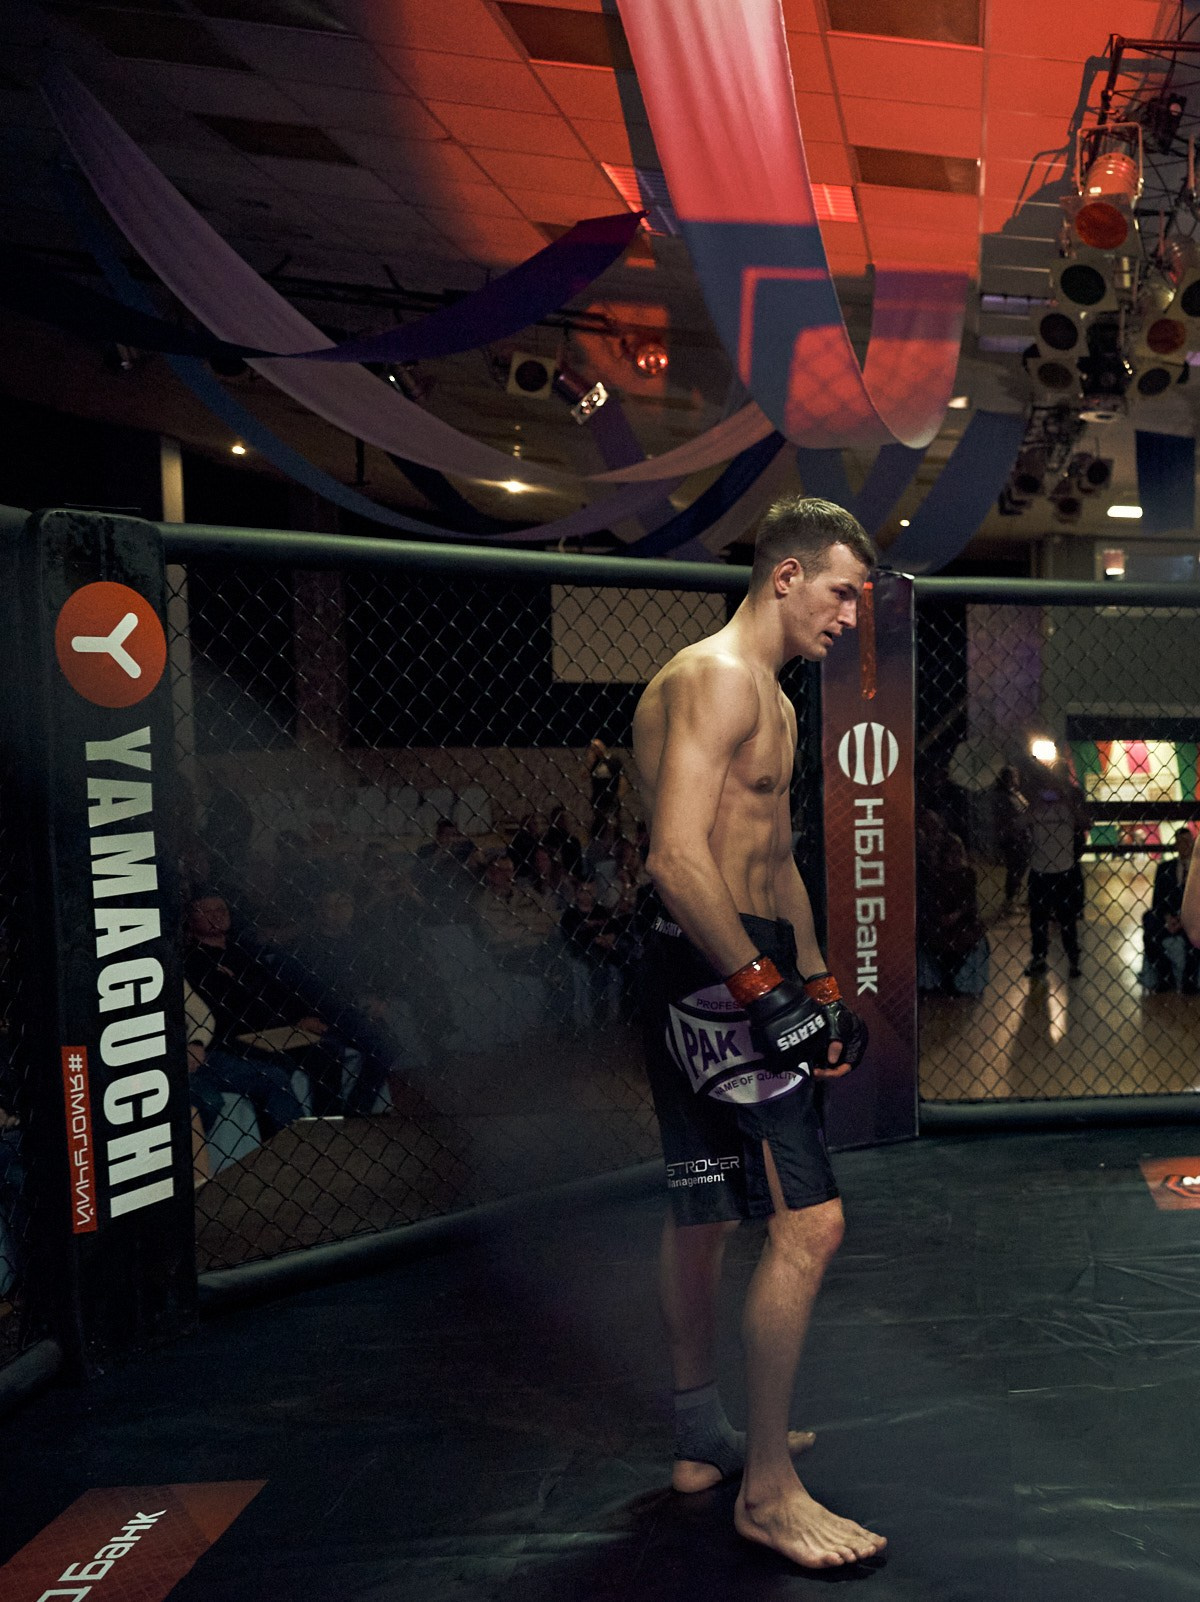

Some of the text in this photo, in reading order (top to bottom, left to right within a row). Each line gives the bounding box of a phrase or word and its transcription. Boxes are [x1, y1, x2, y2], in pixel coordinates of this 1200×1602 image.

[854, 798, 886, 996] НБД Банк
[85, 726, 174, 1218] YAMAGUCHI
[696, 999, 741, 1010] PROFES
[776, 1014, 826, 1052] BEARS
[740, 1075, 754, 1086] OF
[68, 1053, 94, 1226] #ЯМОГУЧИЙ
[57, 1509, 168, 1582] Банк
